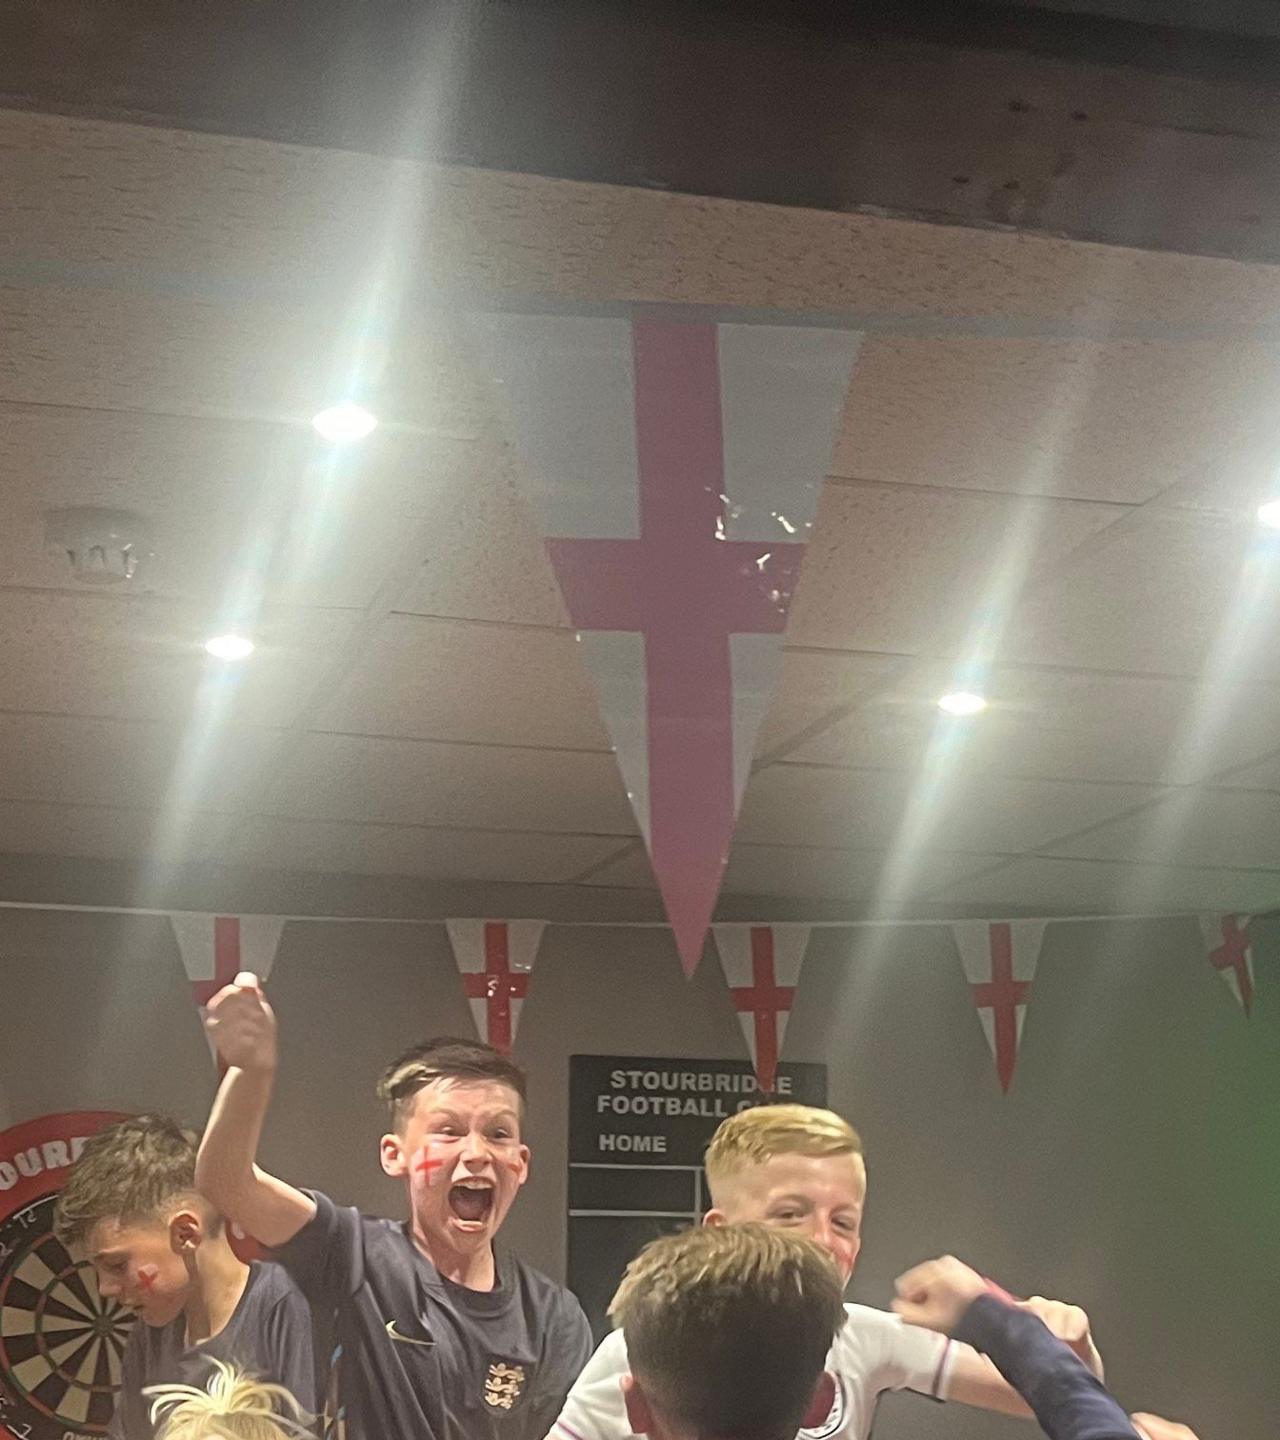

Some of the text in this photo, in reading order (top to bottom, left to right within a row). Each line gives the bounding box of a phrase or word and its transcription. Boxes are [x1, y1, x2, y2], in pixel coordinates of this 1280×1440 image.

[610, 1070, 792, 1095] STOURBRIDE
[597, 1095, 727, 1118] FOOTBALL
[599, 1134, 667, 1153] HOME
